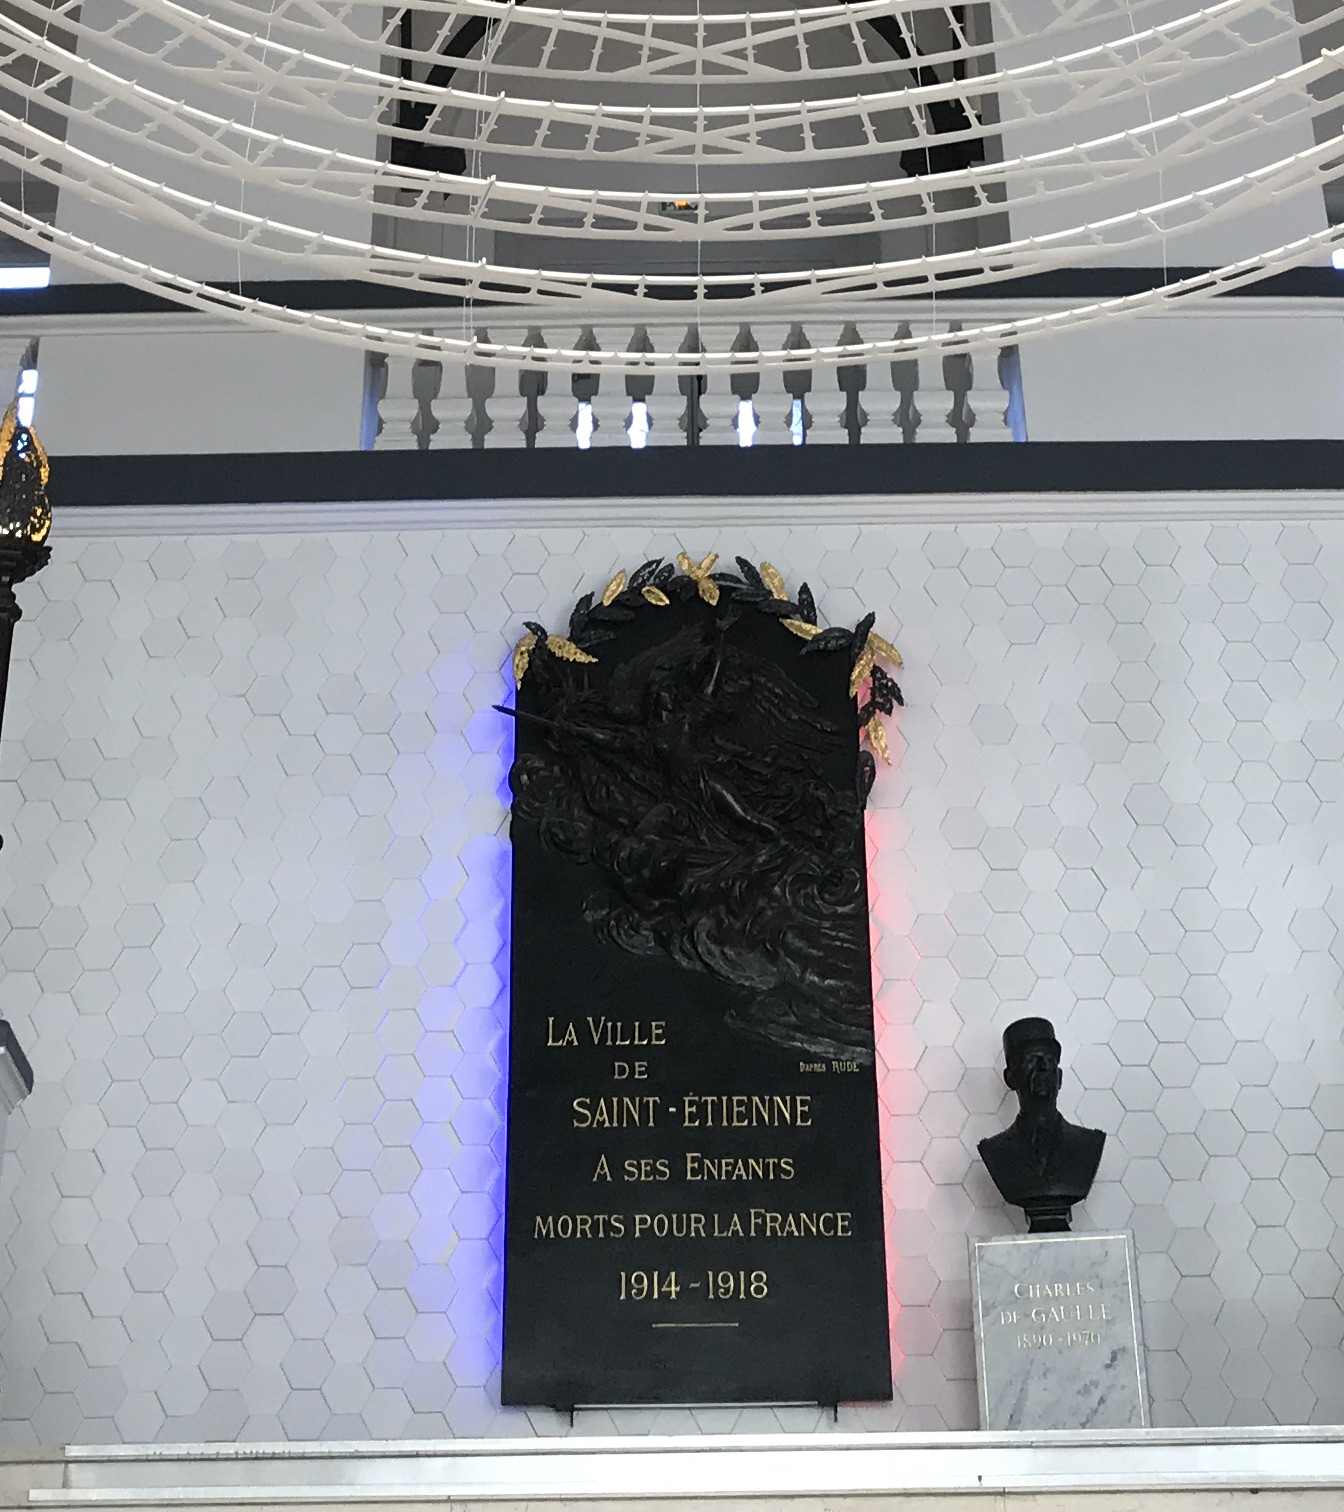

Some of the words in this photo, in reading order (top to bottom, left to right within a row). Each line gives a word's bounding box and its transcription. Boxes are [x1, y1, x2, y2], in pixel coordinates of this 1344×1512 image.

[546, 1016, 578, 1047] LA
[587, 1016, 667, 1047] VILLE
[613, 1061, 649, 1080] DE
[831, 1060, 860, 1074] RUDE
[592, 1153, 613, 1182] A
[623, 1159, 671, 1181] SES
[685, 1152, 795, 1181] ENFANTS
[533, 1214, 625, 1239] MORTS
[633, 1213, 706, 1238] POUR
[713, 1212, 744, 1238] LA
[748, 1208, 853, 1238] FRANCE
[1014, 1282, 1095, 1298] CHARLES
[1000, 1310, 1021, 1325] DE
[1031, 1303, 1113, 1324] GAULLE
